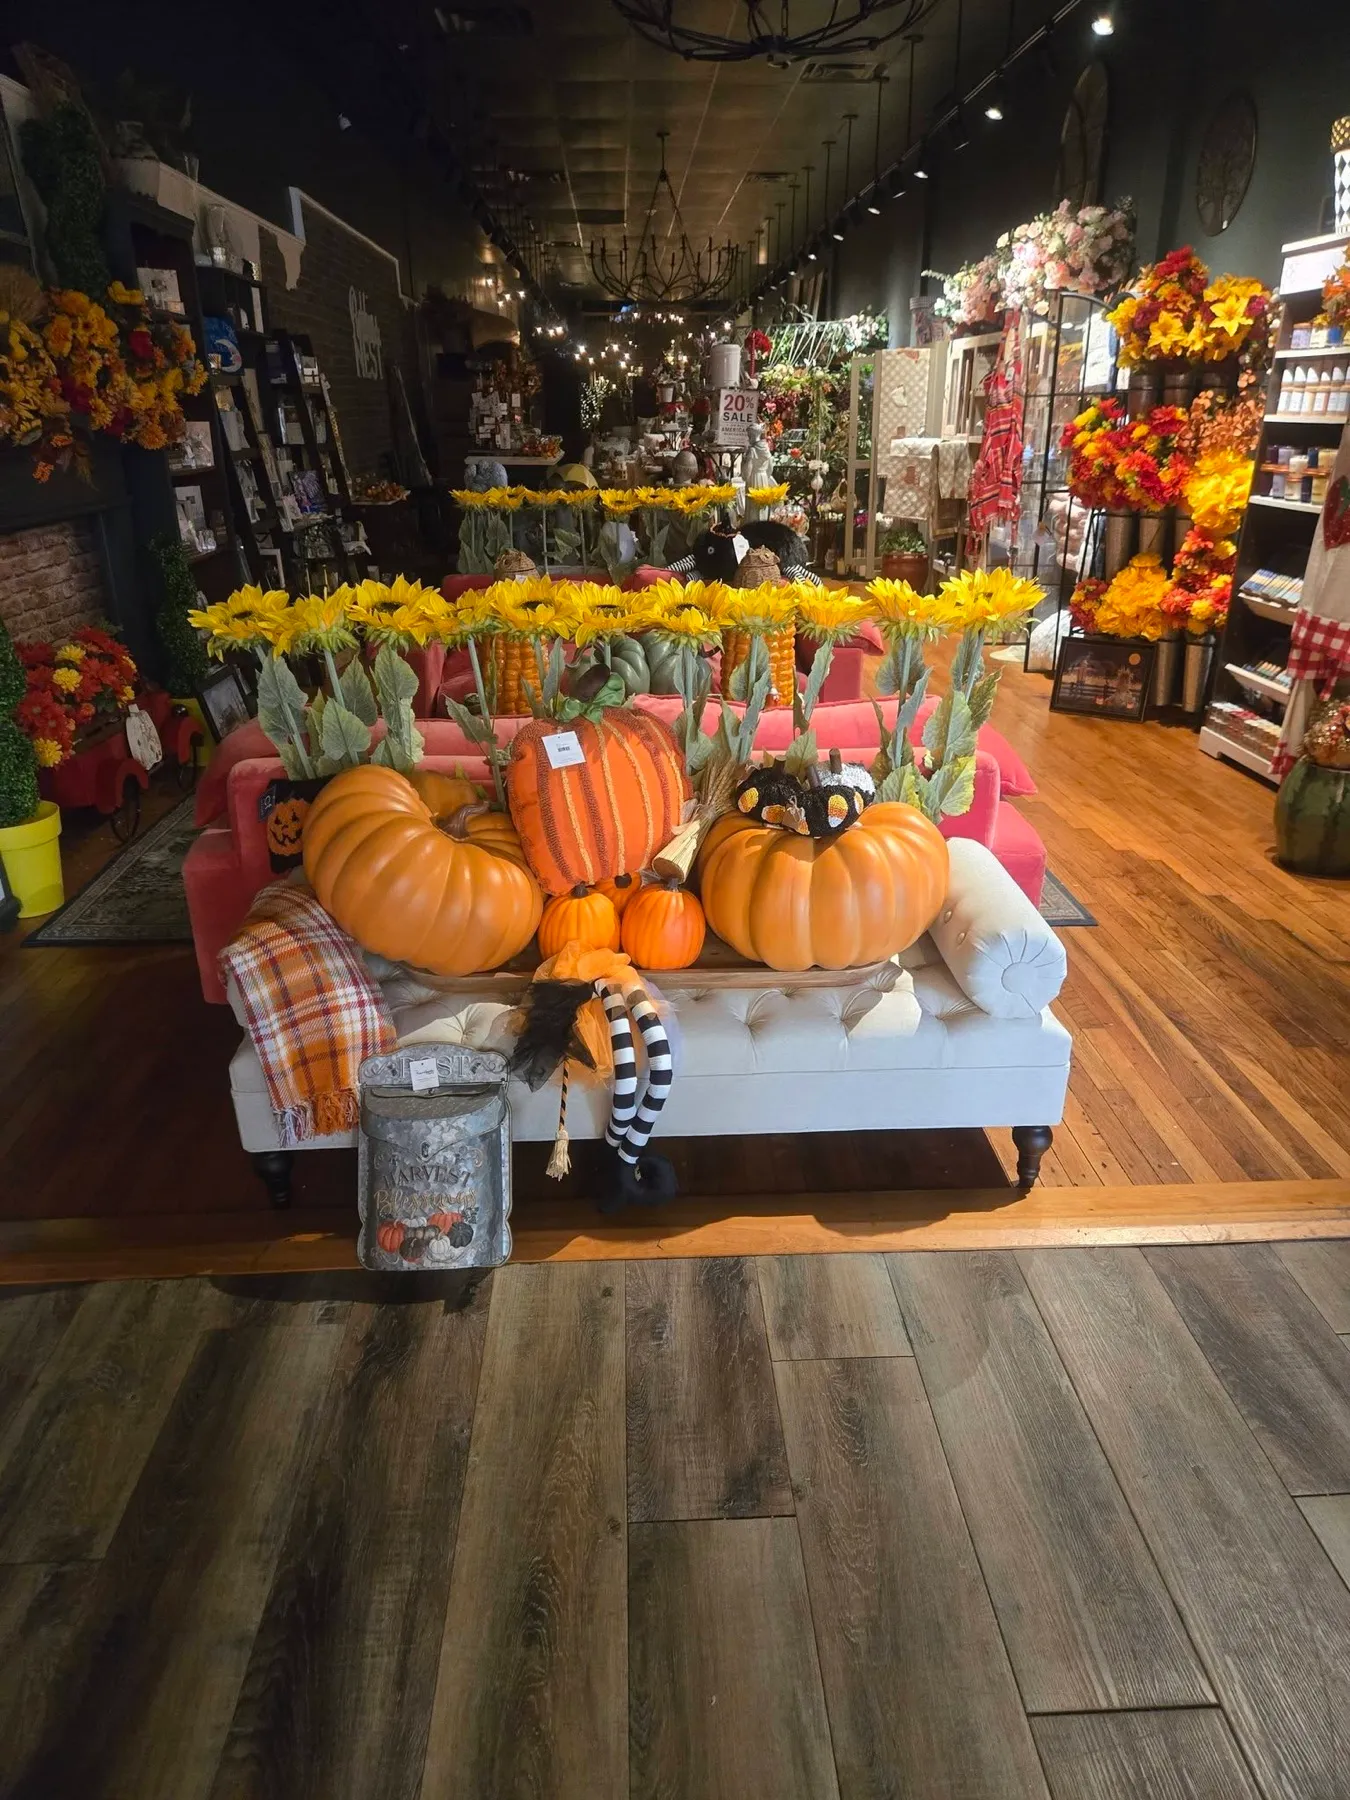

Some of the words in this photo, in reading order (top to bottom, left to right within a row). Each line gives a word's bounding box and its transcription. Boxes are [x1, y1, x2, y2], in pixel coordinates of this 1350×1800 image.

[724, 394, 754, 412] 20%
[722, 412, 753, 423] SALE
[399, 1056, 471, 1078] PST
[382, 1164, 472, 1189] HARVEST
